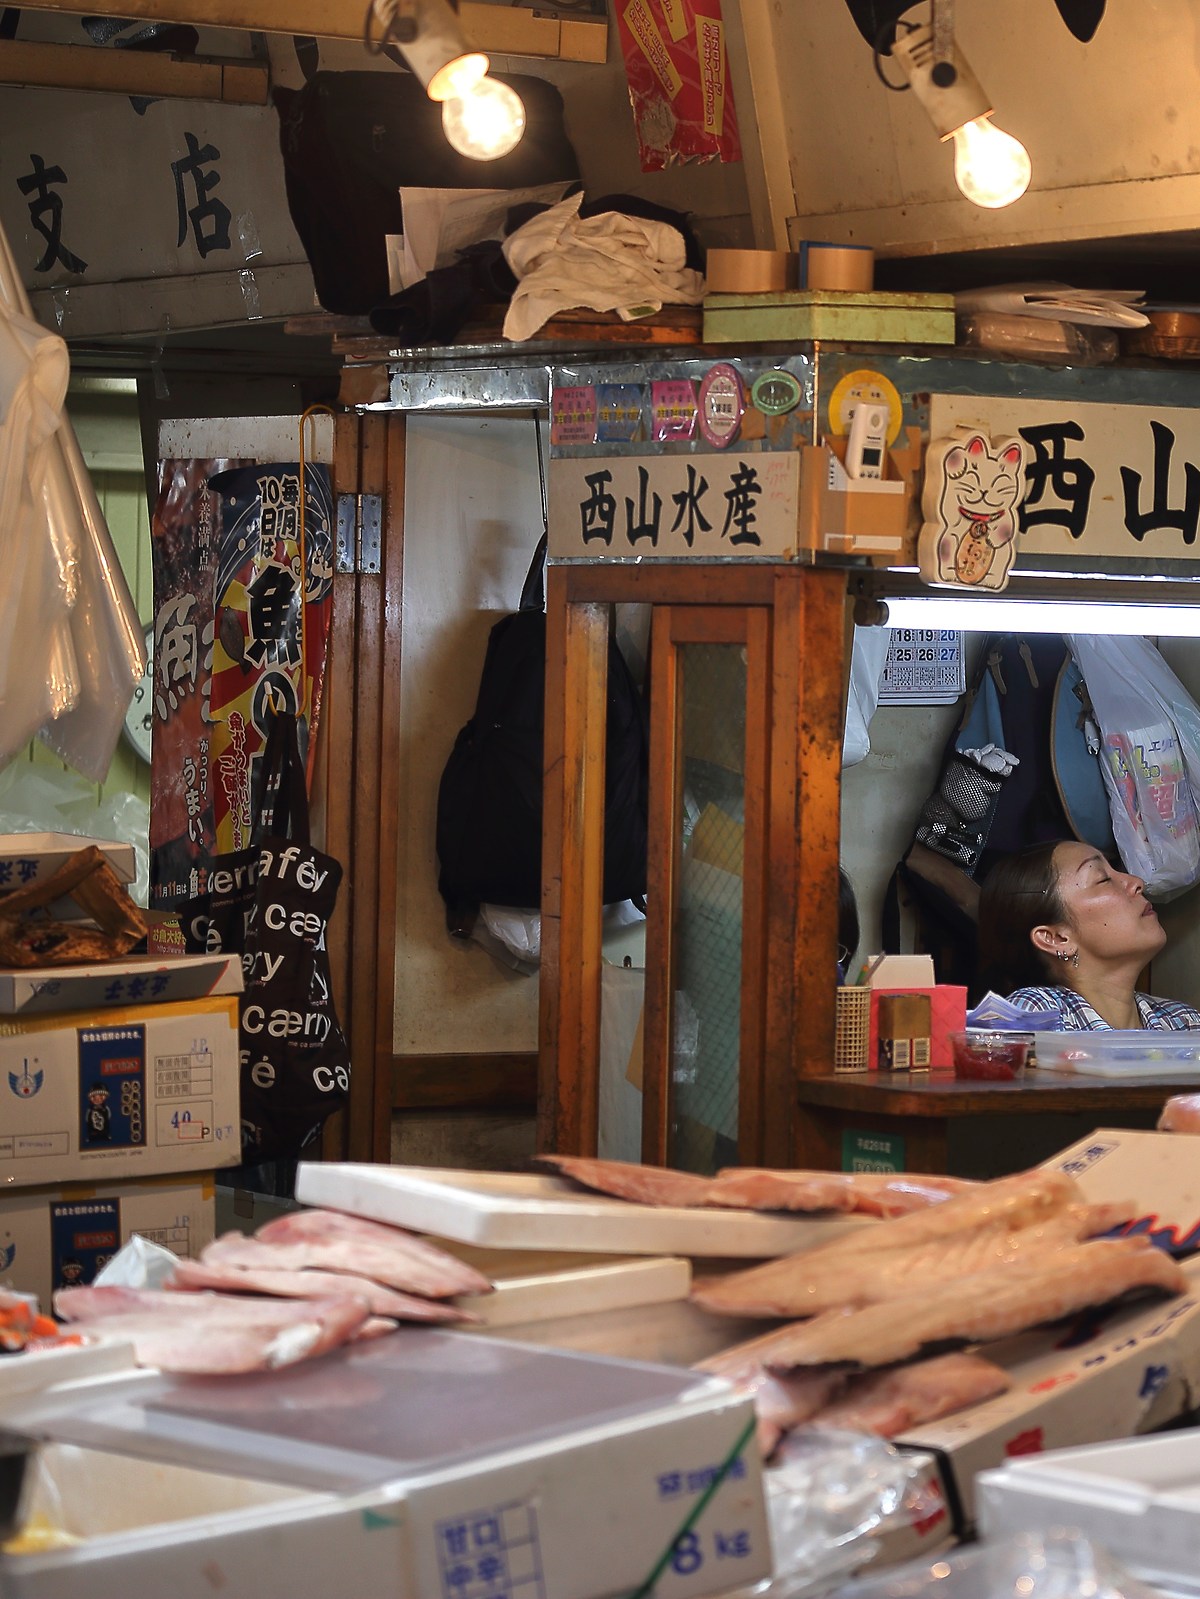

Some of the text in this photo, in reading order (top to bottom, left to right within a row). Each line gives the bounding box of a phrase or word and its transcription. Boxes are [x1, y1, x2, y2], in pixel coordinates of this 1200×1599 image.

[16, 131, 233, 275] 支店
[579, 461, 763, 549] 西山水産
[896, 629, 955, 641] 18 19 20
[896, 648, 956, 661] 25 26 27
